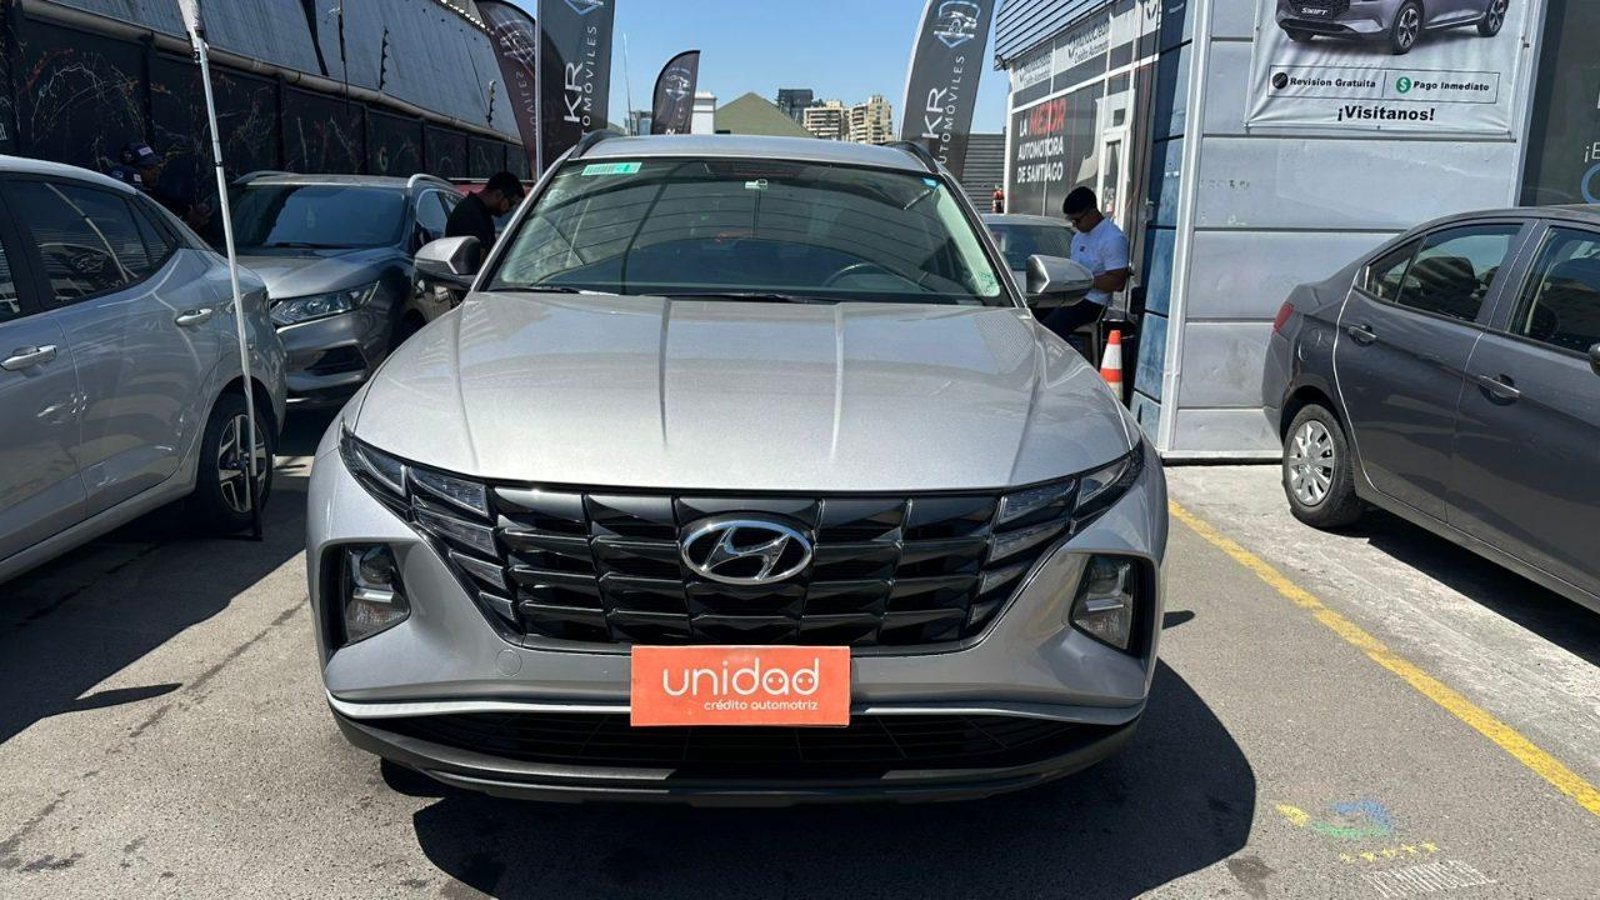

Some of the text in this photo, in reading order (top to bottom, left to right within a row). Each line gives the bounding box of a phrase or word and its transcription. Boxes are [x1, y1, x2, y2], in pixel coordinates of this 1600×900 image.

[580, 25, 597, 136] TOMÓVILES
[1290, 76, 1376, 88] Revision Gratuita
[1413, 80, 1490, 92] Pago Inmediato
[564, 62, 583, 123] KR
[921, 87, 948, 140] KR
[938, 55, 965, 165] UTOMÓVILES
[1338, 104, 1435, 121] ¡Visitanos!
[1019, 118, 1027, 137] LA
[1017, 136, 1064, 161] AUTOMOTORA
[1017, 161, 1063, 183] DE SANTIAGO
[663, 657, 820, 696] unidad
[704, 699, 819, 711] crédito automotriz
